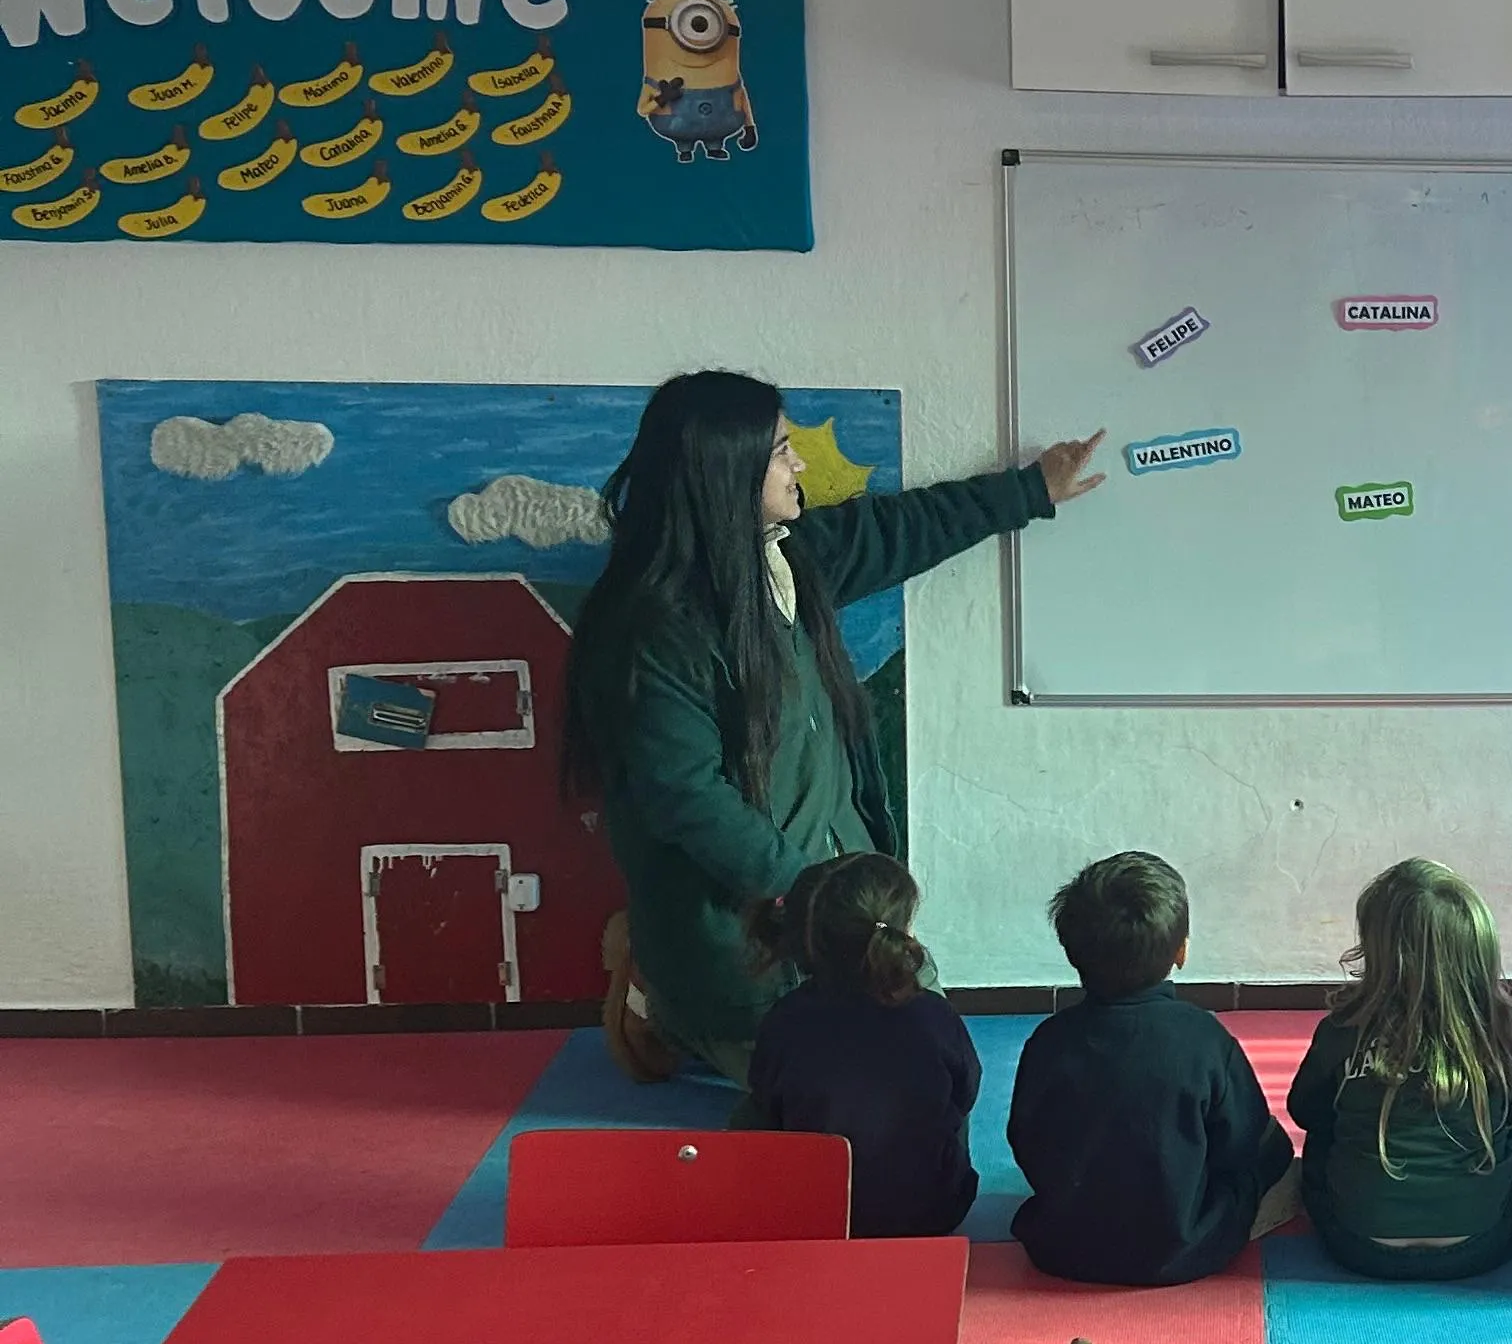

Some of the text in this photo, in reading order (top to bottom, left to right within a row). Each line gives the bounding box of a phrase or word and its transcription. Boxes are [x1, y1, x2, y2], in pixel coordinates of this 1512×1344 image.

[390, 57, 444, 89] Valentino
[39, 90, 87, 121] Jacinta
[148, 86, 183, 102] Juan
[221, 103, 259, 130] Felipe
[319, 129, 372, 161] Catalina
[419, 129, 460, 150] Amelia
[123, 158, 163, 178] Amelia
[240, 154, 279, 183] Mateo
[325, 195, 368, 212] Juana
[144, 215, 178, 231] Julia
[1347, 306, 1431, 320] CATALINA
[1147, 318, 1199, 358] FELIPE
[1136, 438, 1232, 466] VALENTINO
[1348, 492, 1405, 510] MATEO
